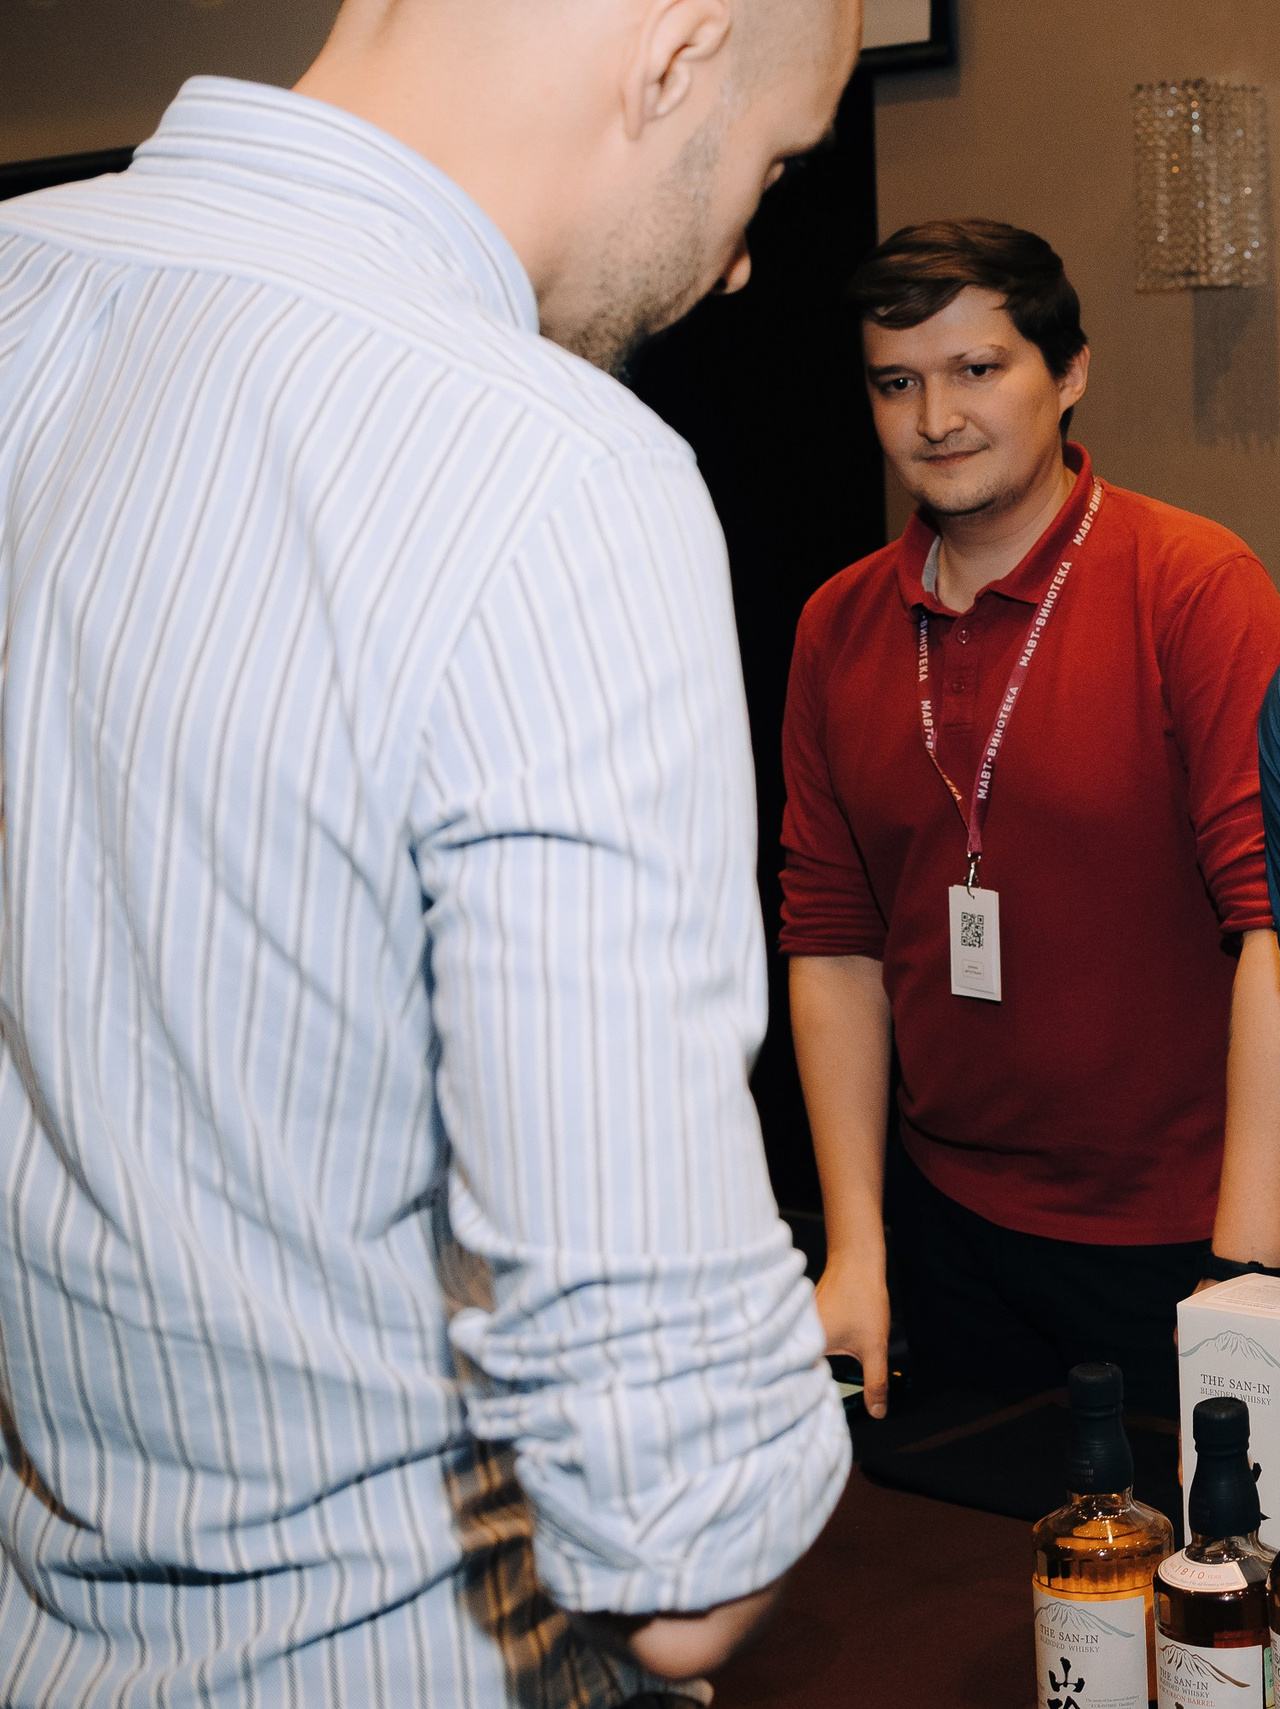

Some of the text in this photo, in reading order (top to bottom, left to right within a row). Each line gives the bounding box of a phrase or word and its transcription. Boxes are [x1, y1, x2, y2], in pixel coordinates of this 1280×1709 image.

[1201, 1374, 1270, 1394] THE SAN-IN
[1240, 1393, 1272, 1405] WHISKY
[1040, 1623, 1099, 1644] THE SAN-IN
[1068, 1645, 1100, 1653] WHISKY
[1159, 1667, 1209, 1691] THE SAN-IN
[1182, 1687, 1210, 1698] WHISKY
[1187, 1696, 1215, 1708] BARREL
